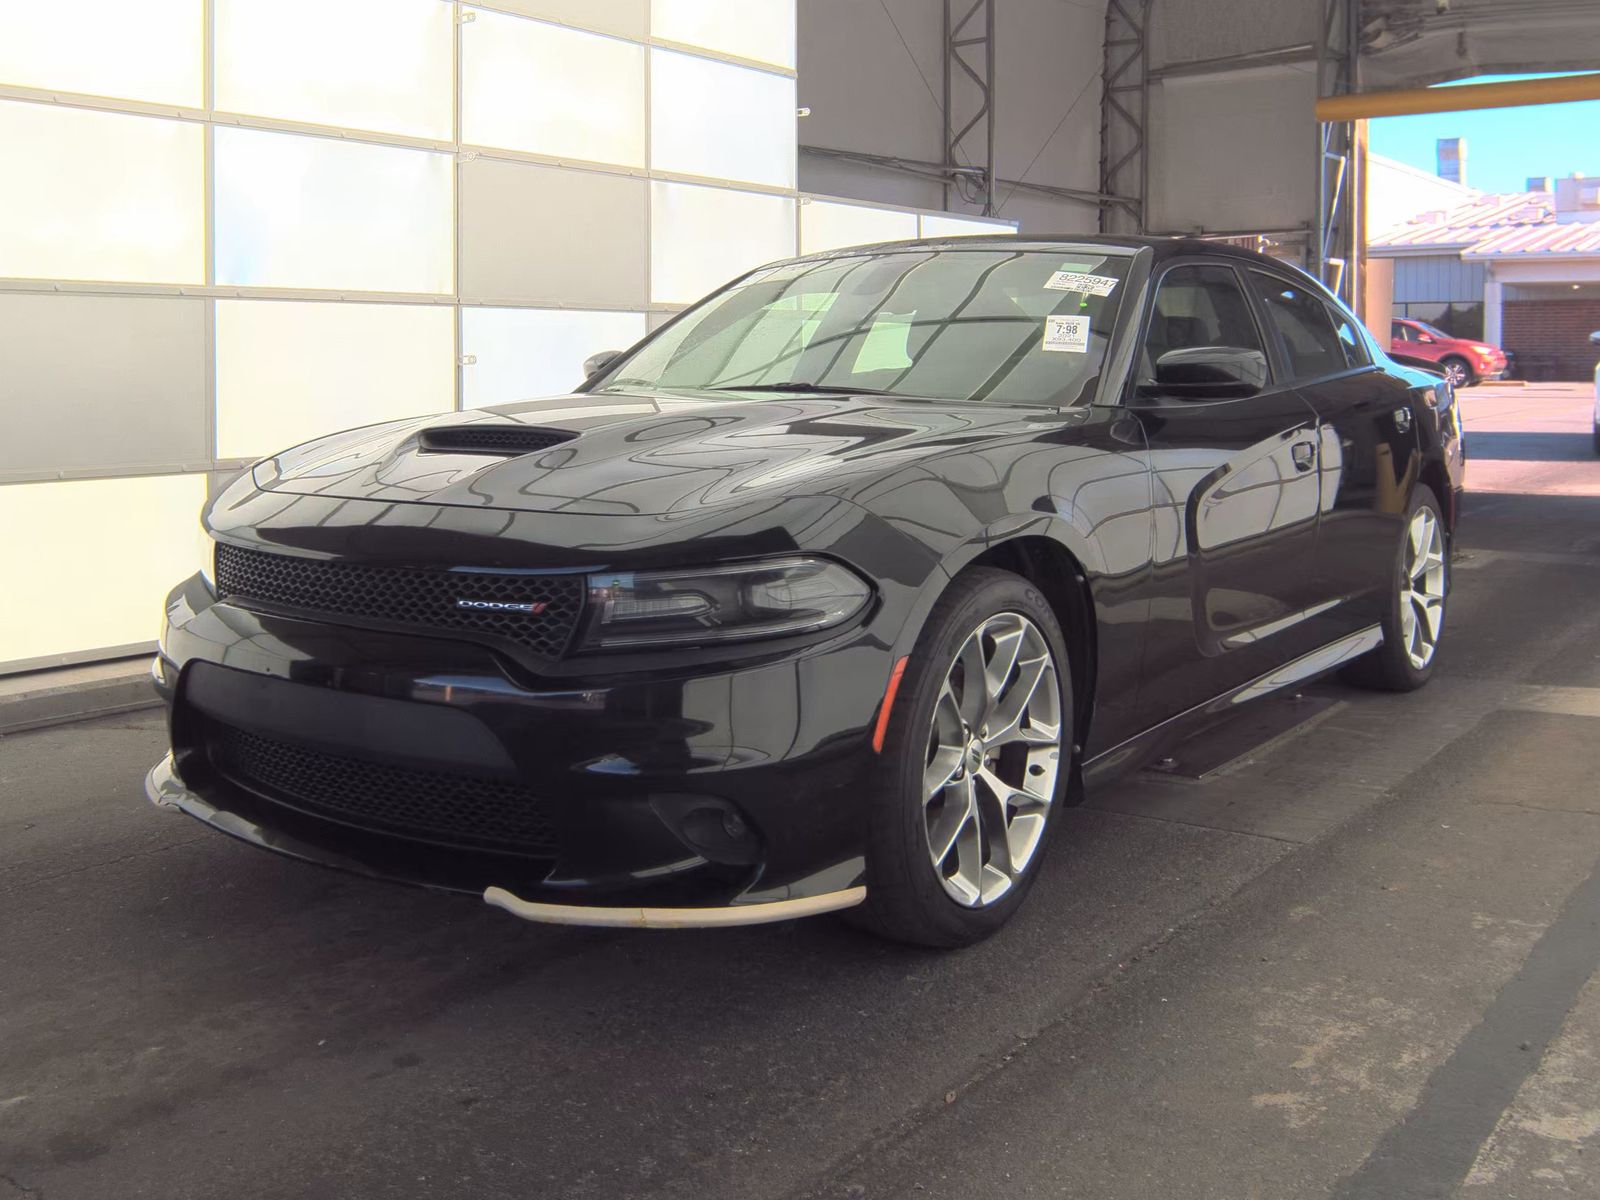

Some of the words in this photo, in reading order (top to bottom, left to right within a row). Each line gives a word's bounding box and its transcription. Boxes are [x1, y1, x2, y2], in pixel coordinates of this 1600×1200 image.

[1059, 273, 1117, 287] 8225947
[1056, 325, 1078, 335] 7:98
[459, 600, 534, 611] DODGE
